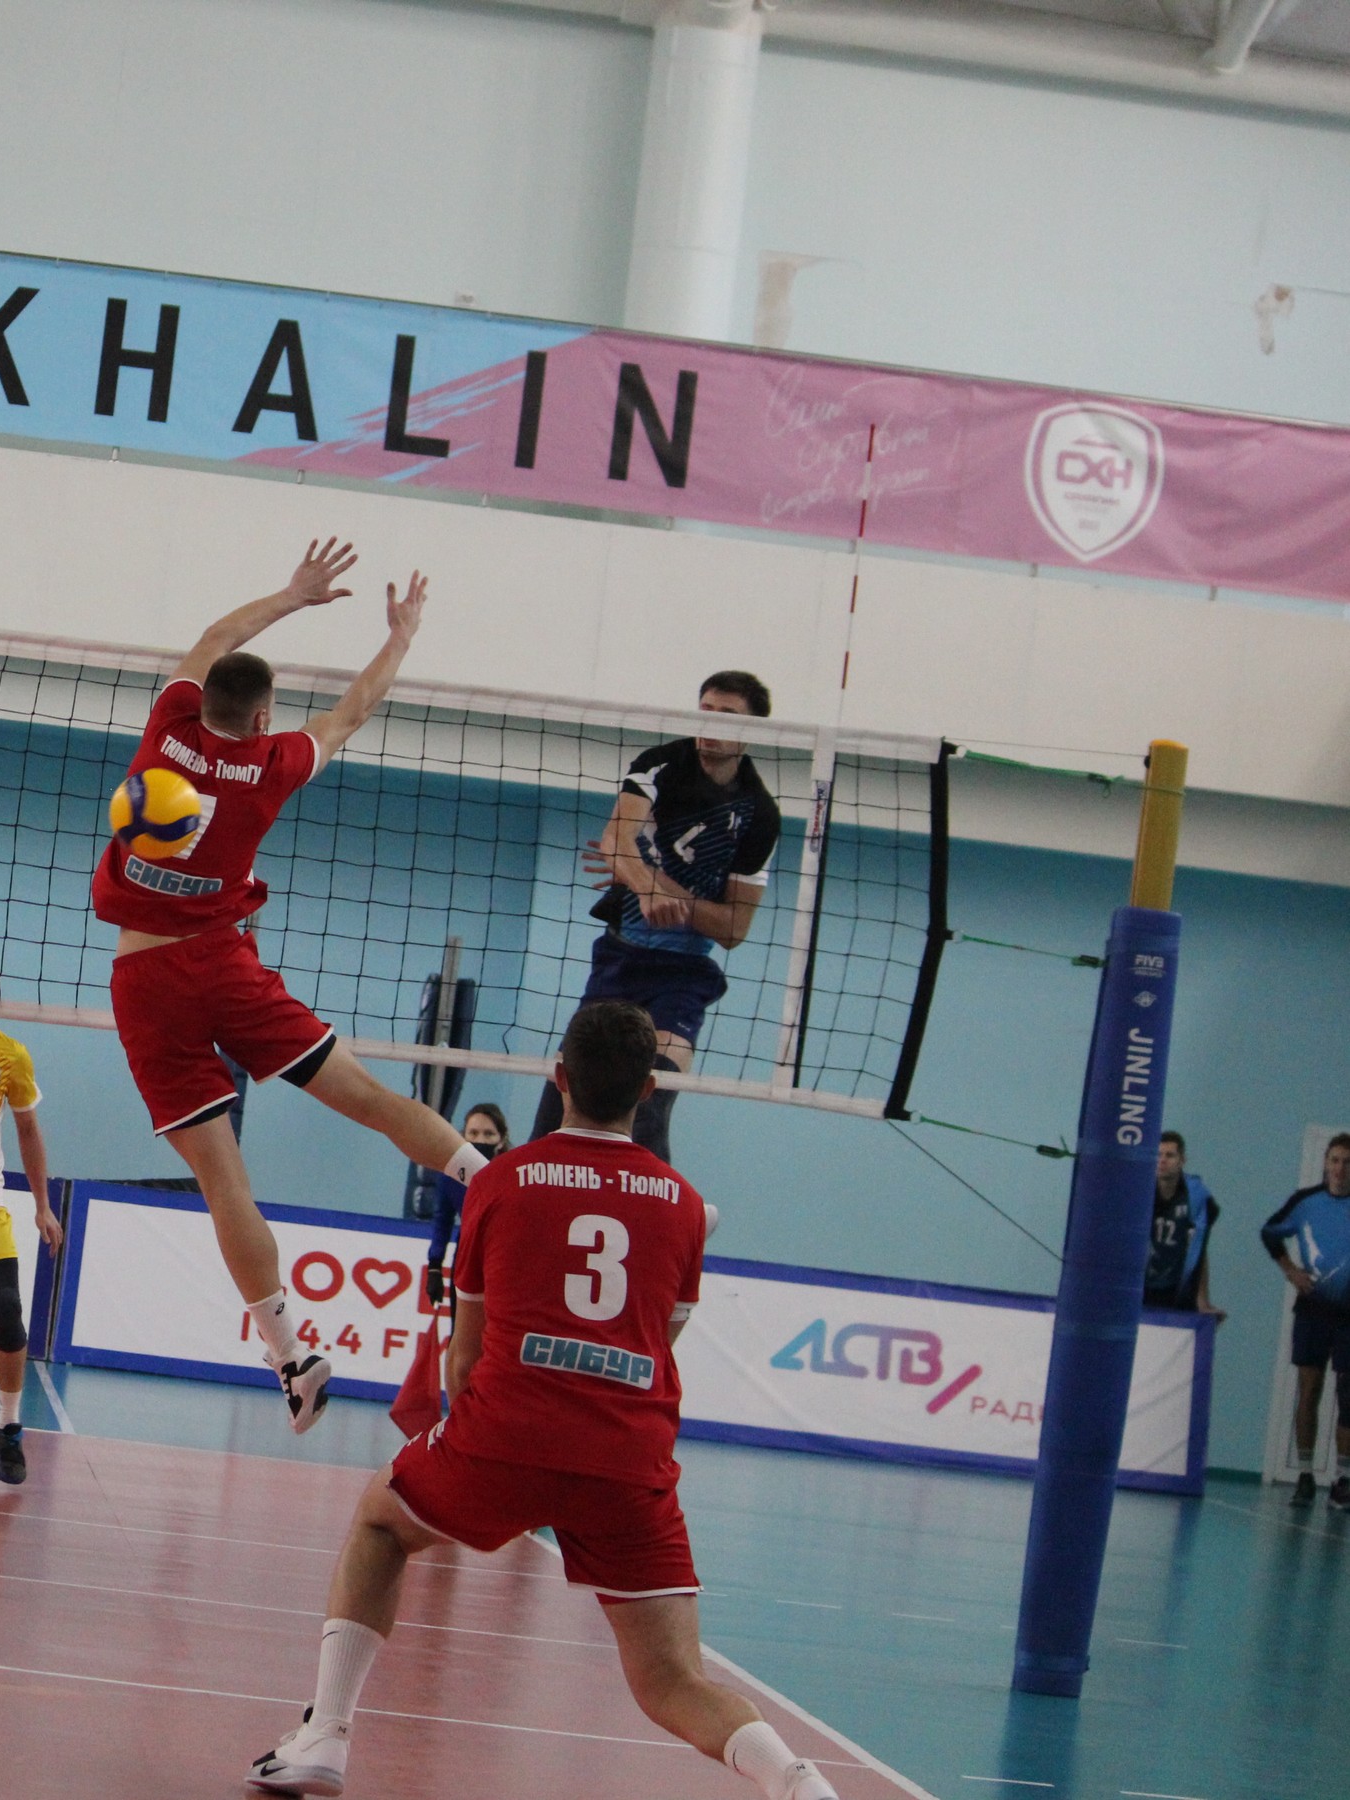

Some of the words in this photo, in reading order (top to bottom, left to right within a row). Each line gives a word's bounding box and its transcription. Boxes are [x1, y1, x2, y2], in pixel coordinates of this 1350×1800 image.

[160, 734, 208, 775] ТЮМЕНЬ
[125, 856, 222, 896] СИБУР
[1116, 1027, 1154, 1146] JINLING
[516, 1162, 600, 1190] ТЮМЕНЬ
[1155, 1216, 1178, 1246] 12
[563, 1214, 630, 1321] 3
[521, 1333, 652, 1388] СИБУР
[770, 1318, 943, 1386] АСТВ
